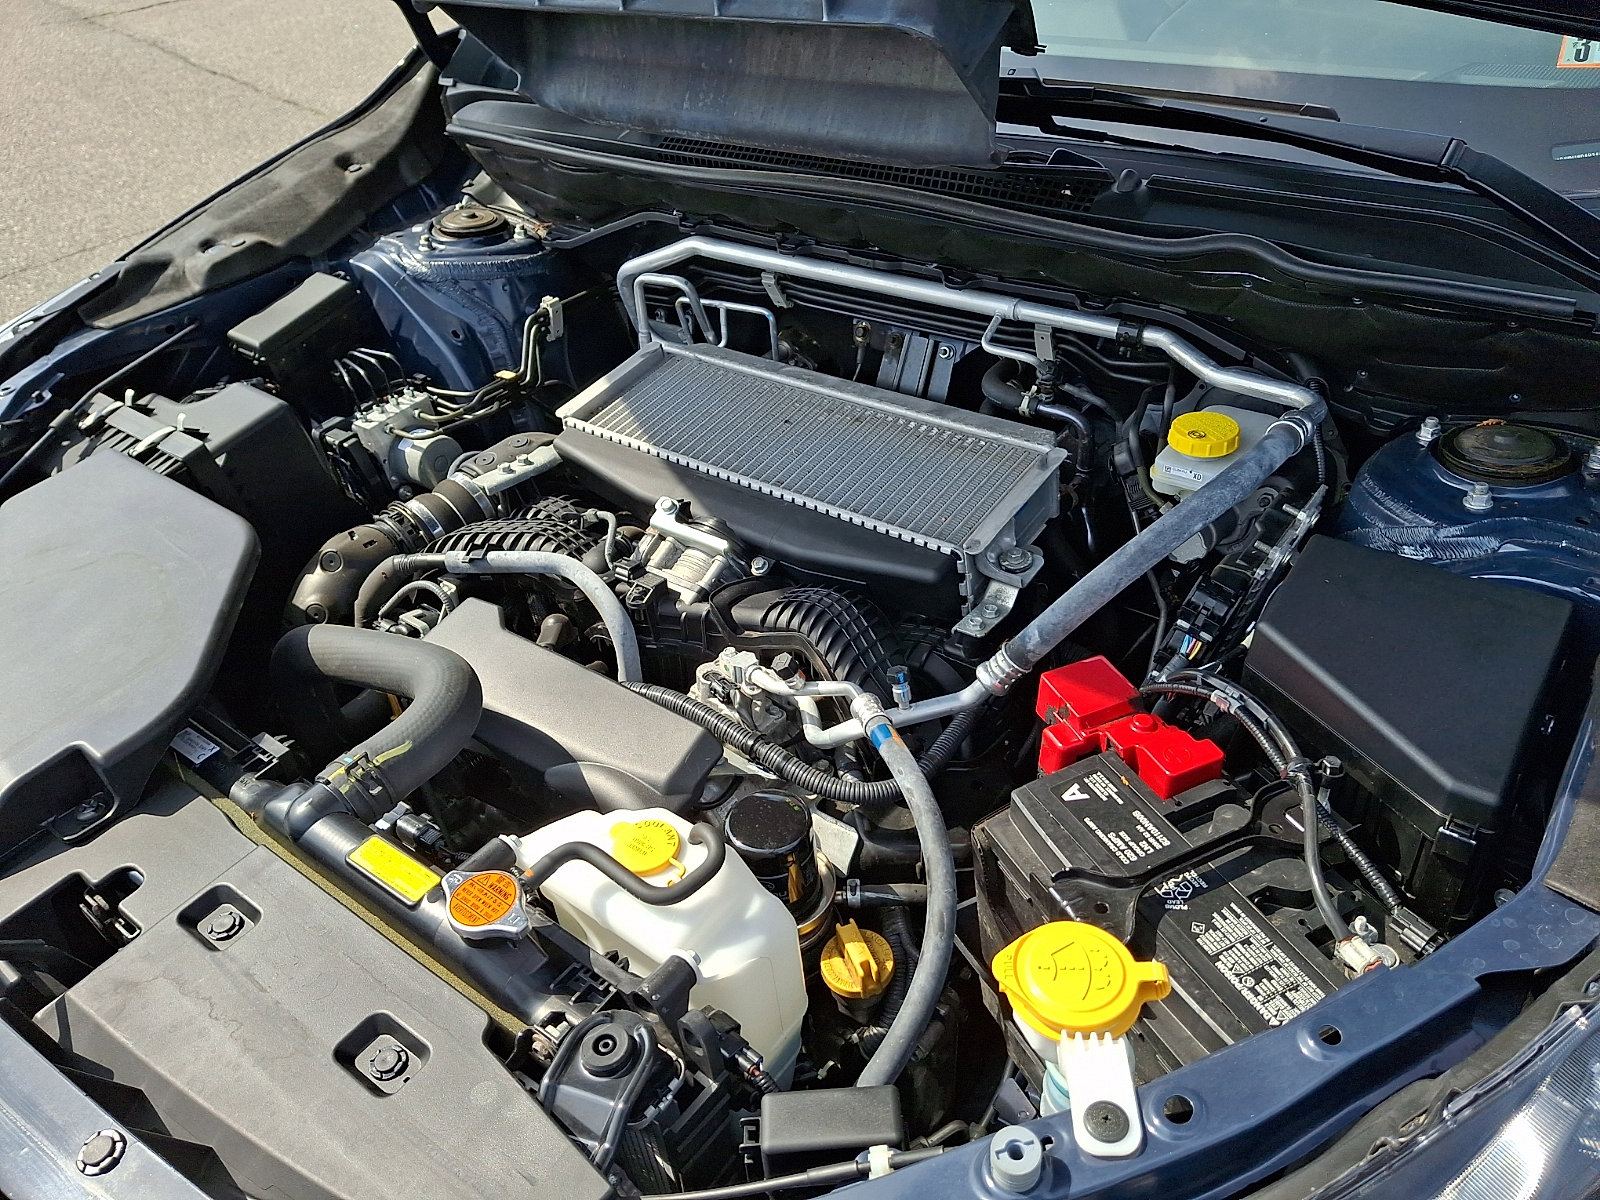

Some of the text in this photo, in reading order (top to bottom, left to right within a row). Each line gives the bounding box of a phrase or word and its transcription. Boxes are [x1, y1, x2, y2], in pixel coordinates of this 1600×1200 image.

[1061, 783, 1090, 802] A
[634, 820, 677, 847] COOLANT
[1084, 817, 1129, 864] COLD CRANKING AMPS
[1108, 832, 1137, 861] 620 AMPS
[1128, 841, 1145, 857] GROUP
[1139, 840, 1154, 854] LN2
[1183, 872, 1200, 888] RECYC
[1189, 869, 1208, 889] RECYCL
[488, 881, 512, 900] WARNING
[1215, 961, 1271, 1019] DANGER/POISON
